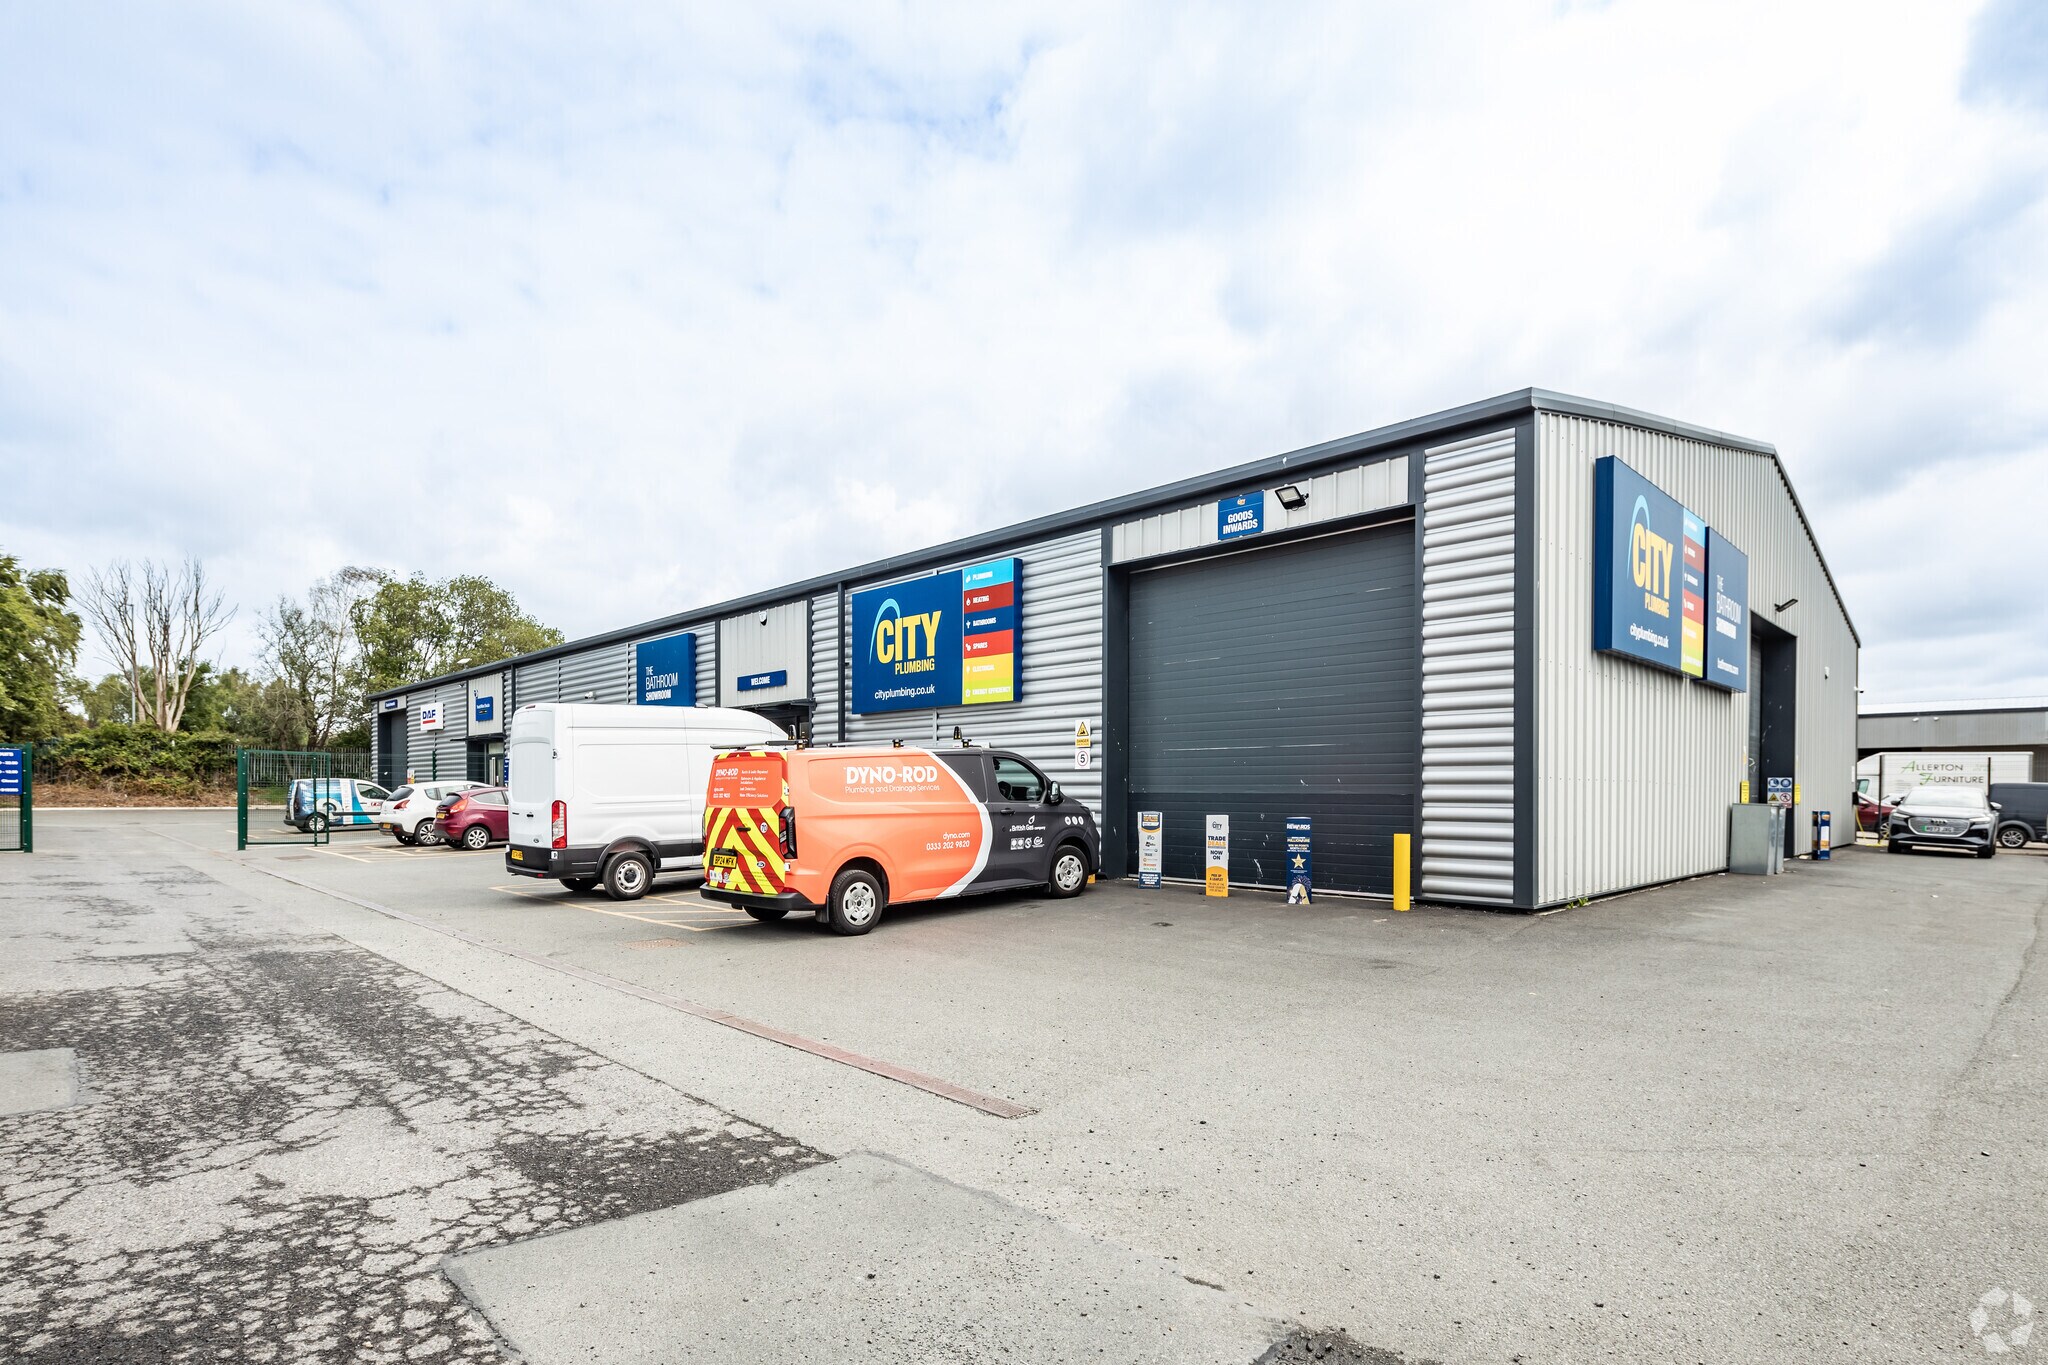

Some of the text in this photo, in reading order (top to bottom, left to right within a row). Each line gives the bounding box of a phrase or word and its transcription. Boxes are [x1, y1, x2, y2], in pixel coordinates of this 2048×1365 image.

[1228, 510, 1253, 523] GOODS
[1223, 519, 1258, 534] INWARDS
[1633, 523, 1674, 600] CITY
[1645, 592, 1669, 618] PLUMBING
[877, 610, 942, 664] CITY
[895, 658, 935, 675] PLUMBING
[646, 672, 678, 690] BATHROOM
[751, 676, 770, 686] WELCOME
[646, 690, 671, 701] SHOWROOM
[874, 684, 935, 700] cityplumbing.co.uk
[422, 710, 436, 720] DAF
[1080, 754, 1085, 763] 5
[716, 768, 738, 776] DYNO-ROD
[1901, 761, 1963, 773] ALLERTON
[846, 766, 937, 784] DYNO-ROD
[1919, 773, 1984, 785] FURNITURE
[845, 786, 874, 794] Plumbing
[943, 832, 970, 840] dyno.com
